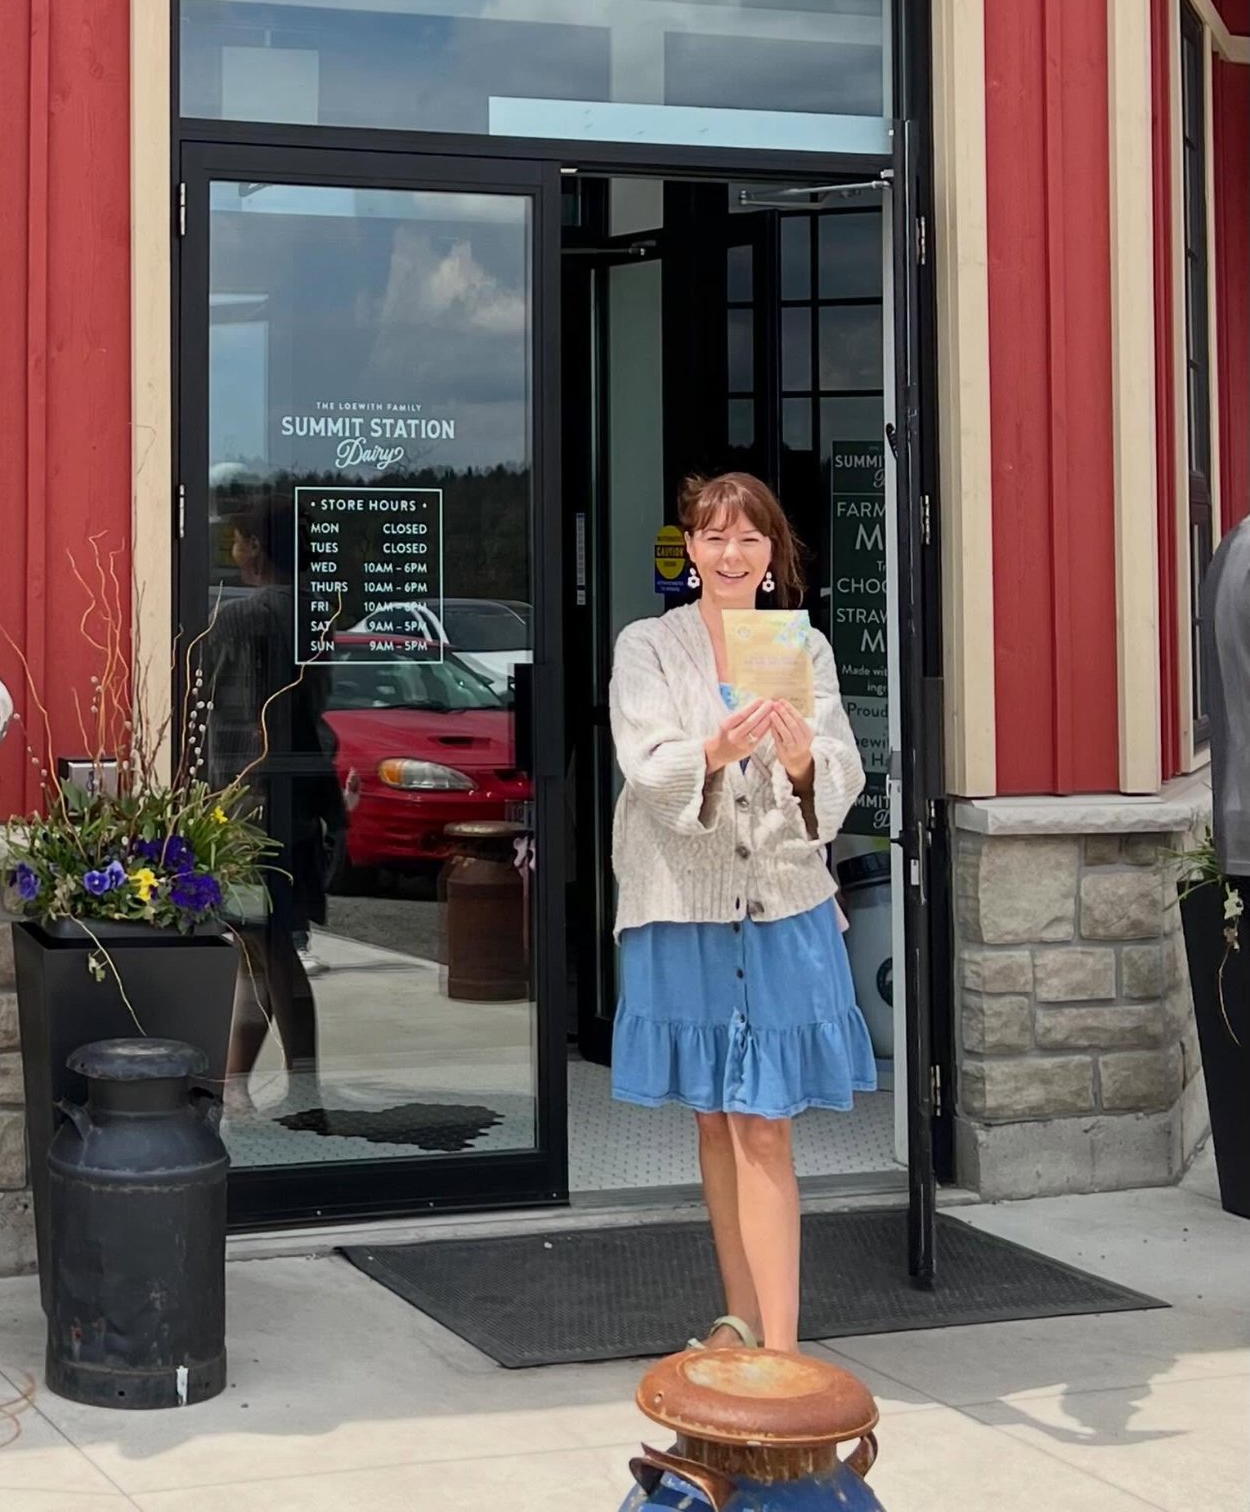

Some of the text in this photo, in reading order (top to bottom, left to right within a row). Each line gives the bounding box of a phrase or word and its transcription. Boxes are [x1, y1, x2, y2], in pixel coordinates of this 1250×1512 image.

[316, 401, 422, 412] THE LOEWITH FAMILY
[281, 416, 455, 439] SUMMIT STATION
[335, 437, 404, 470] Dairy
[834, 454, 885, 468] SUMMI
[321, 499, 417, 512] STORE HOURS
[310, 522, 428, 534] MON CLOSED
[310, 542, 428, 554] TUES CLOSED
[310, 562, 337, 573] WED
[364, 562, 394, 573] 10AM
[404, 562, 428, 574] 6PM
[364, 582, 394, 593] 10AM
[404, 582, 428, 593] 6PM
[310, 601, 329, 612] FRI
[368, 621, 394, 632] 9AM
[404, 621, 428, 632] 5PM
[370, 640, 394, 651] 9AM
[404, 640, 428, 652] 5PM
